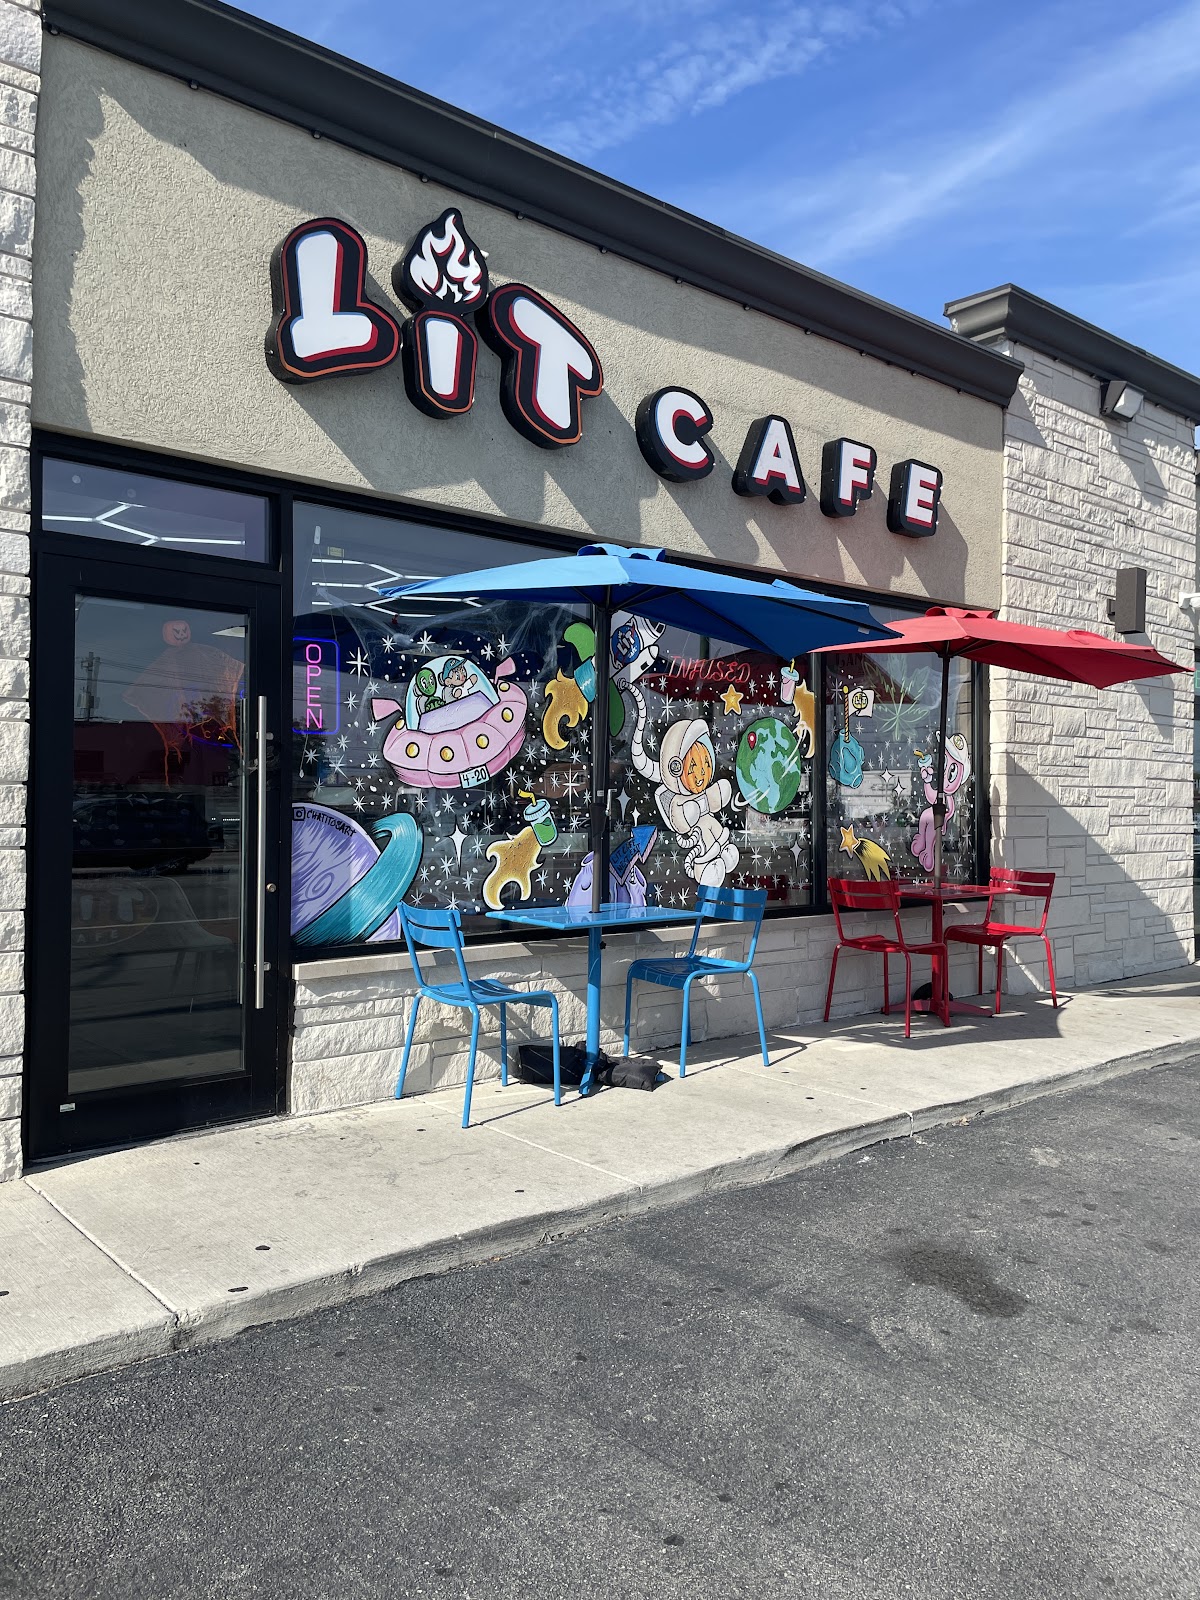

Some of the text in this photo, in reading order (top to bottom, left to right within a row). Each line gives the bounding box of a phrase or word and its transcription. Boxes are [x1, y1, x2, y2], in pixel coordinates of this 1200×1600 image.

[653, 390, 939, 529] CAFE
[305, 643, 323, 729] OPEN
[667, 655, 751, 683] INFUSED
[76, 929, 119, 944] AFE
